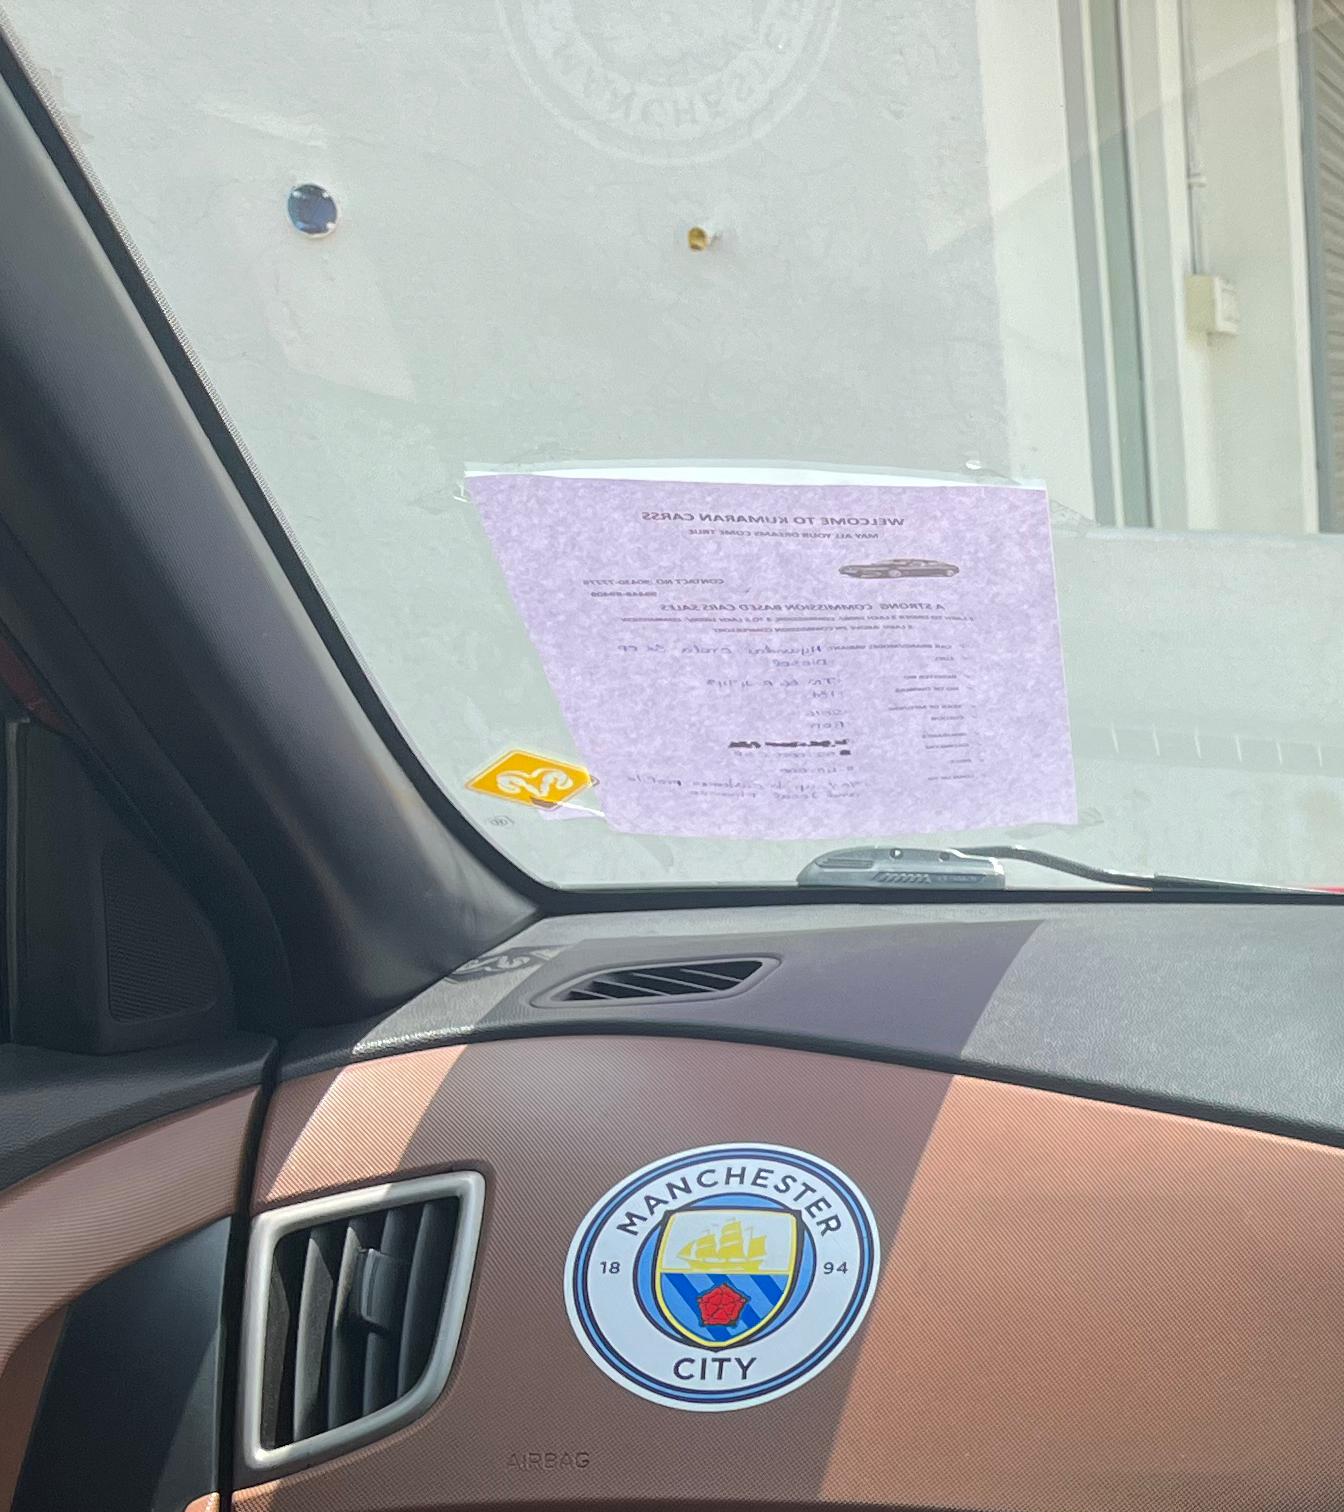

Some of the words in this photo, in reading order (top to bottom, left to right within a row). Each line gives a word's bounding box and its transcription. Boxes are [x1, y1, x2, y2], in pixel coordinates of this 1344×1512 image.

[616, 1166, 842, 1237] MANCHESTER
[600, 1261, 621, 1274] 18
[823, 1261, 848, 1275] 94
[673, 1357, 757, 1381] CITY
[507, 1452, 590, 1470] AIRBAG
